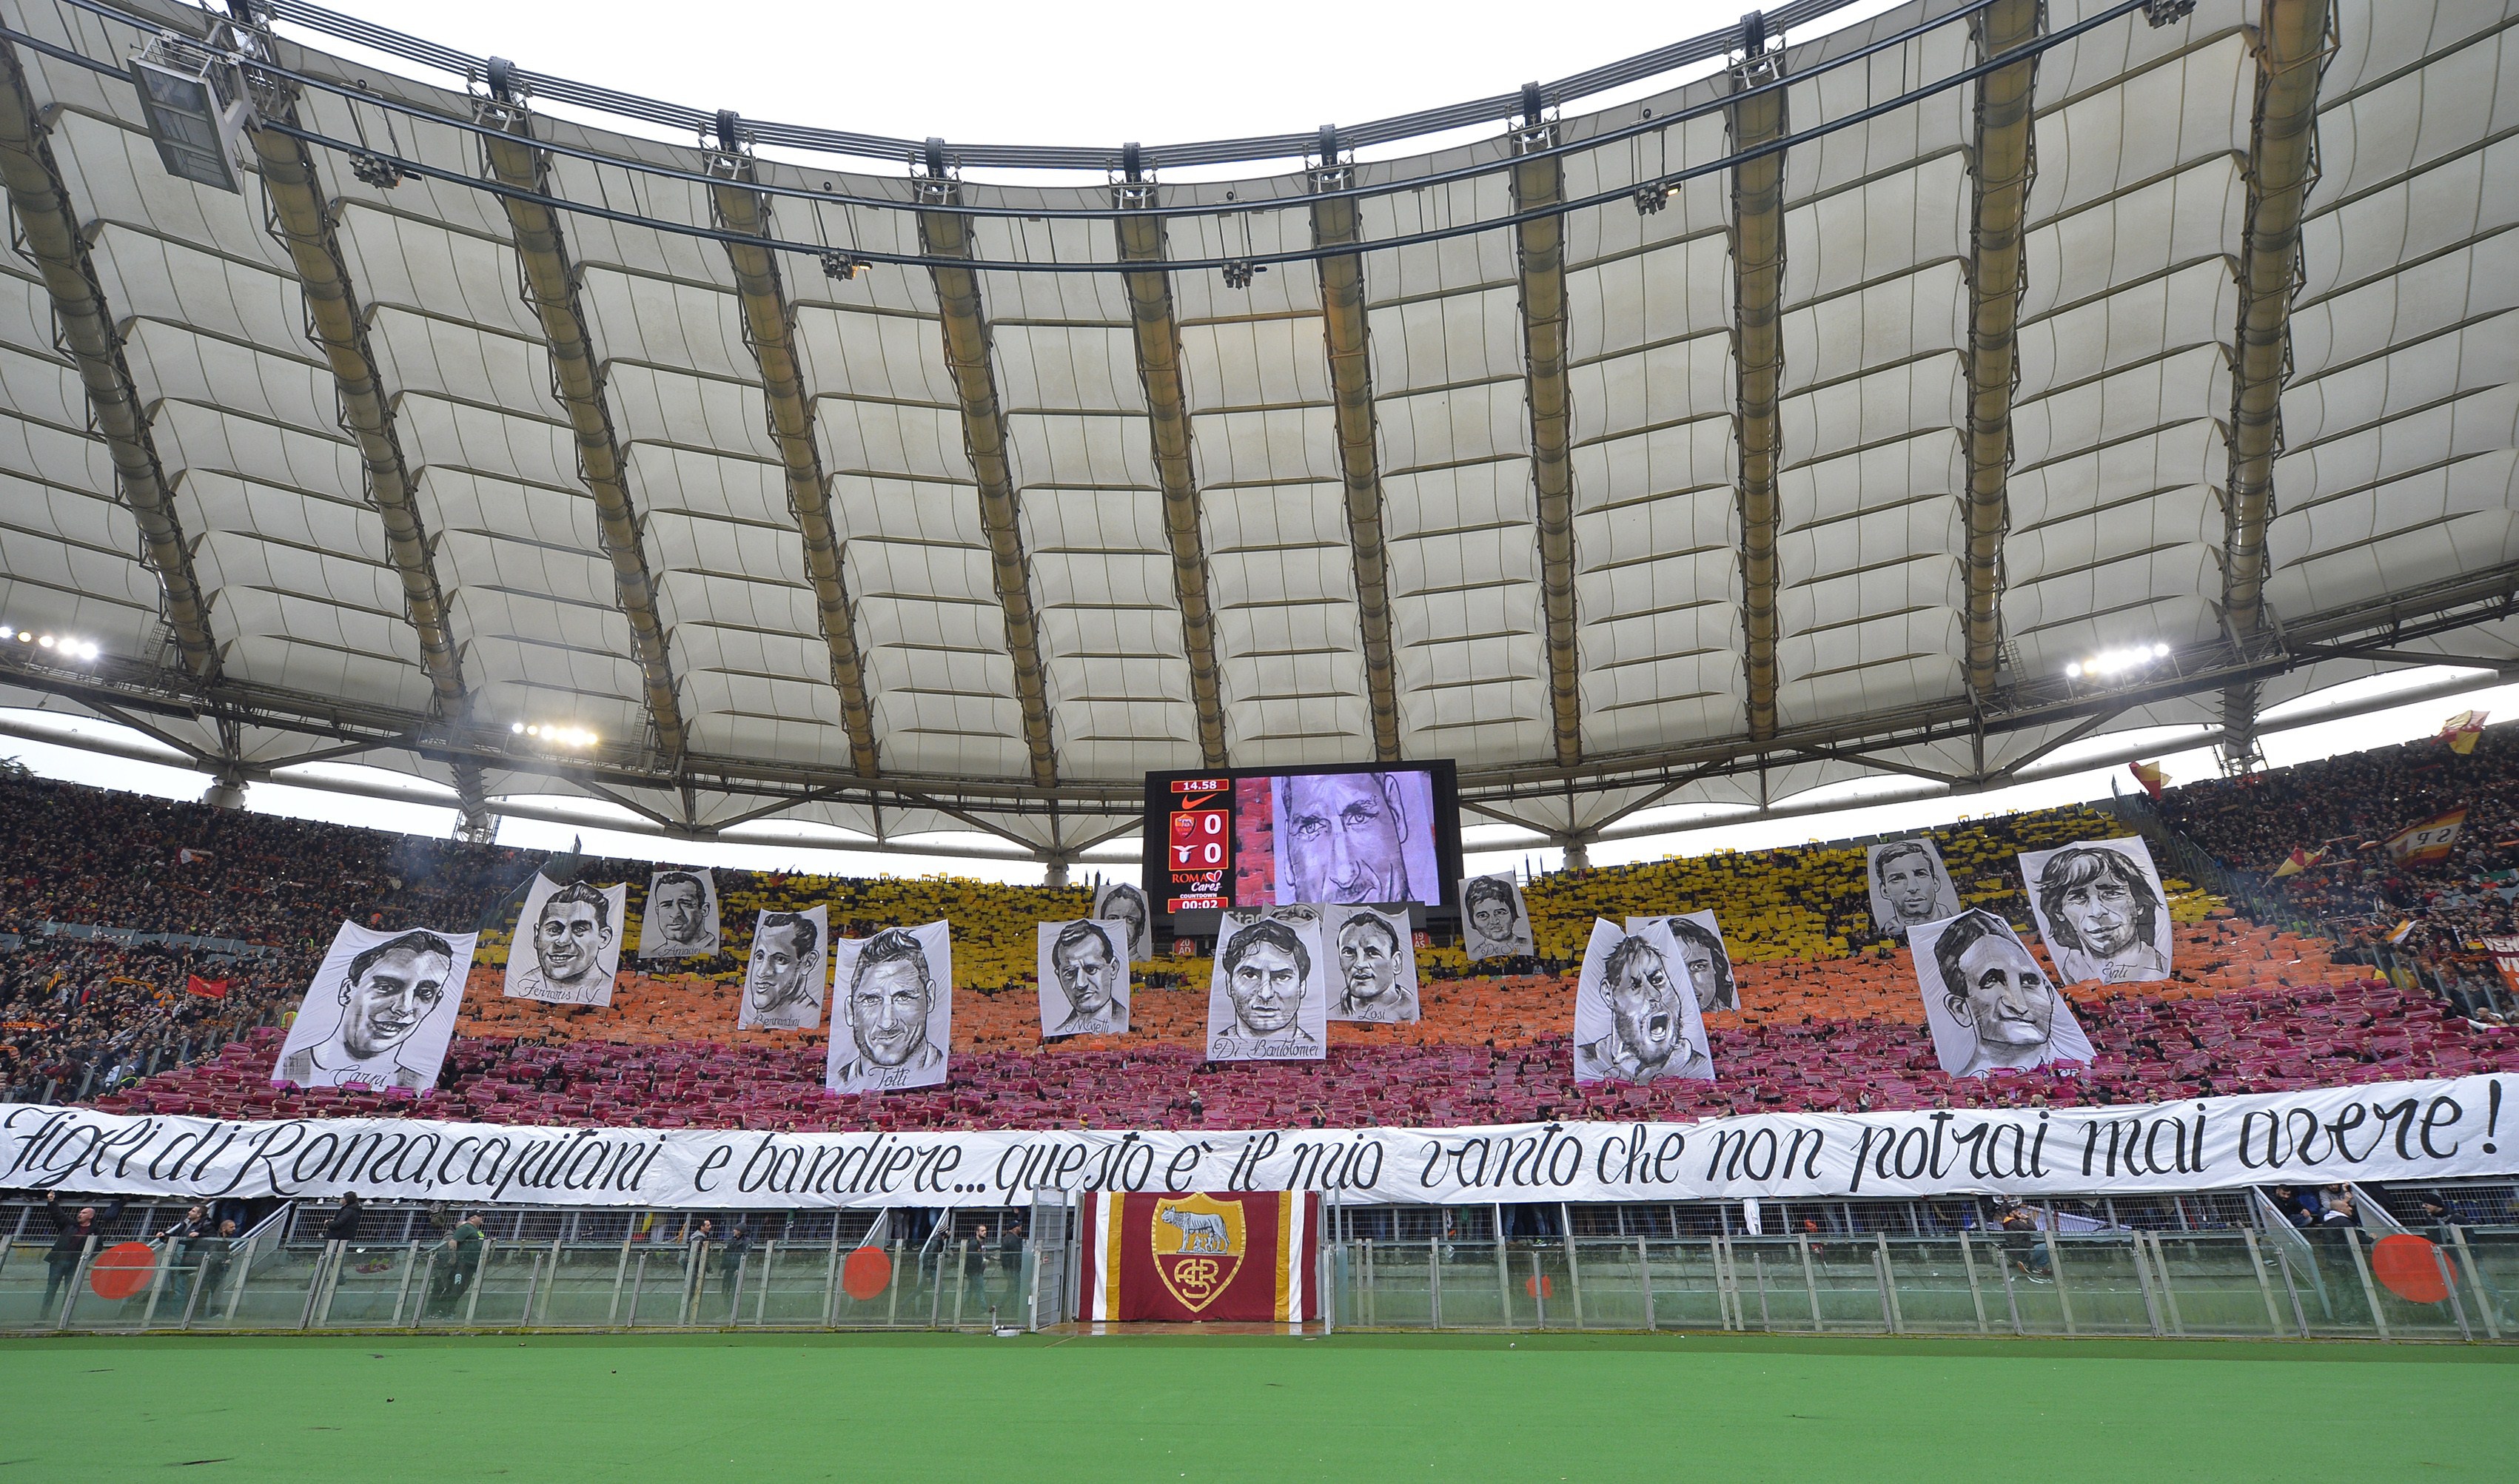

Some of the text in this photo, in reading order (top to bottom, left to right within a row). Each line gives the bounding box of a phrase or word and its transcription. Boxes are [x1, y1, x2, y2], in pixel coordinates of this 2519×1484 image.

[1183, 781, 1217, 790] 14.58
[1204, 813, 1221, 835] 0
[1204, 842, 1221, 863] 0
[1172, 873, 1208, 883] ROMA
[1191, 882, 1223, 892] Cares
[1181, 899, 1218, 910] 00:02
[1179, 939, 1190, 947] 20
[1414, 932, 1424, 940] 19
[1414, 940, 1426, 948] AS
[517, 978, 571, 1000] Ferraris
[1358, 1004, 1386, 1021] Losi
[1065, 1016, 1110, 1033] Masetti
[1212, 1038, 1320, 1058] Di Bartolomei
[868, 1066, 910, 1090] Totti
[0, 1107, 164, 1189] Figli
[148, 1121, 243, 1183] di
[694, 1145, 733, 1192] e
[995, 1131, 1155, 1206] questo
[1227, 1130, 1280, 1192] il
[1287, 1132, 1384, 1191] mio
[1419, 1124, 1583, 1189] vanto
[1597, 1123, 1686, 1185] che
[1705, 1127, 1825, 1181] non
[1850, 1111, 2050, 1193] potrai
[2077, 1102, 2212, 1178] mai
